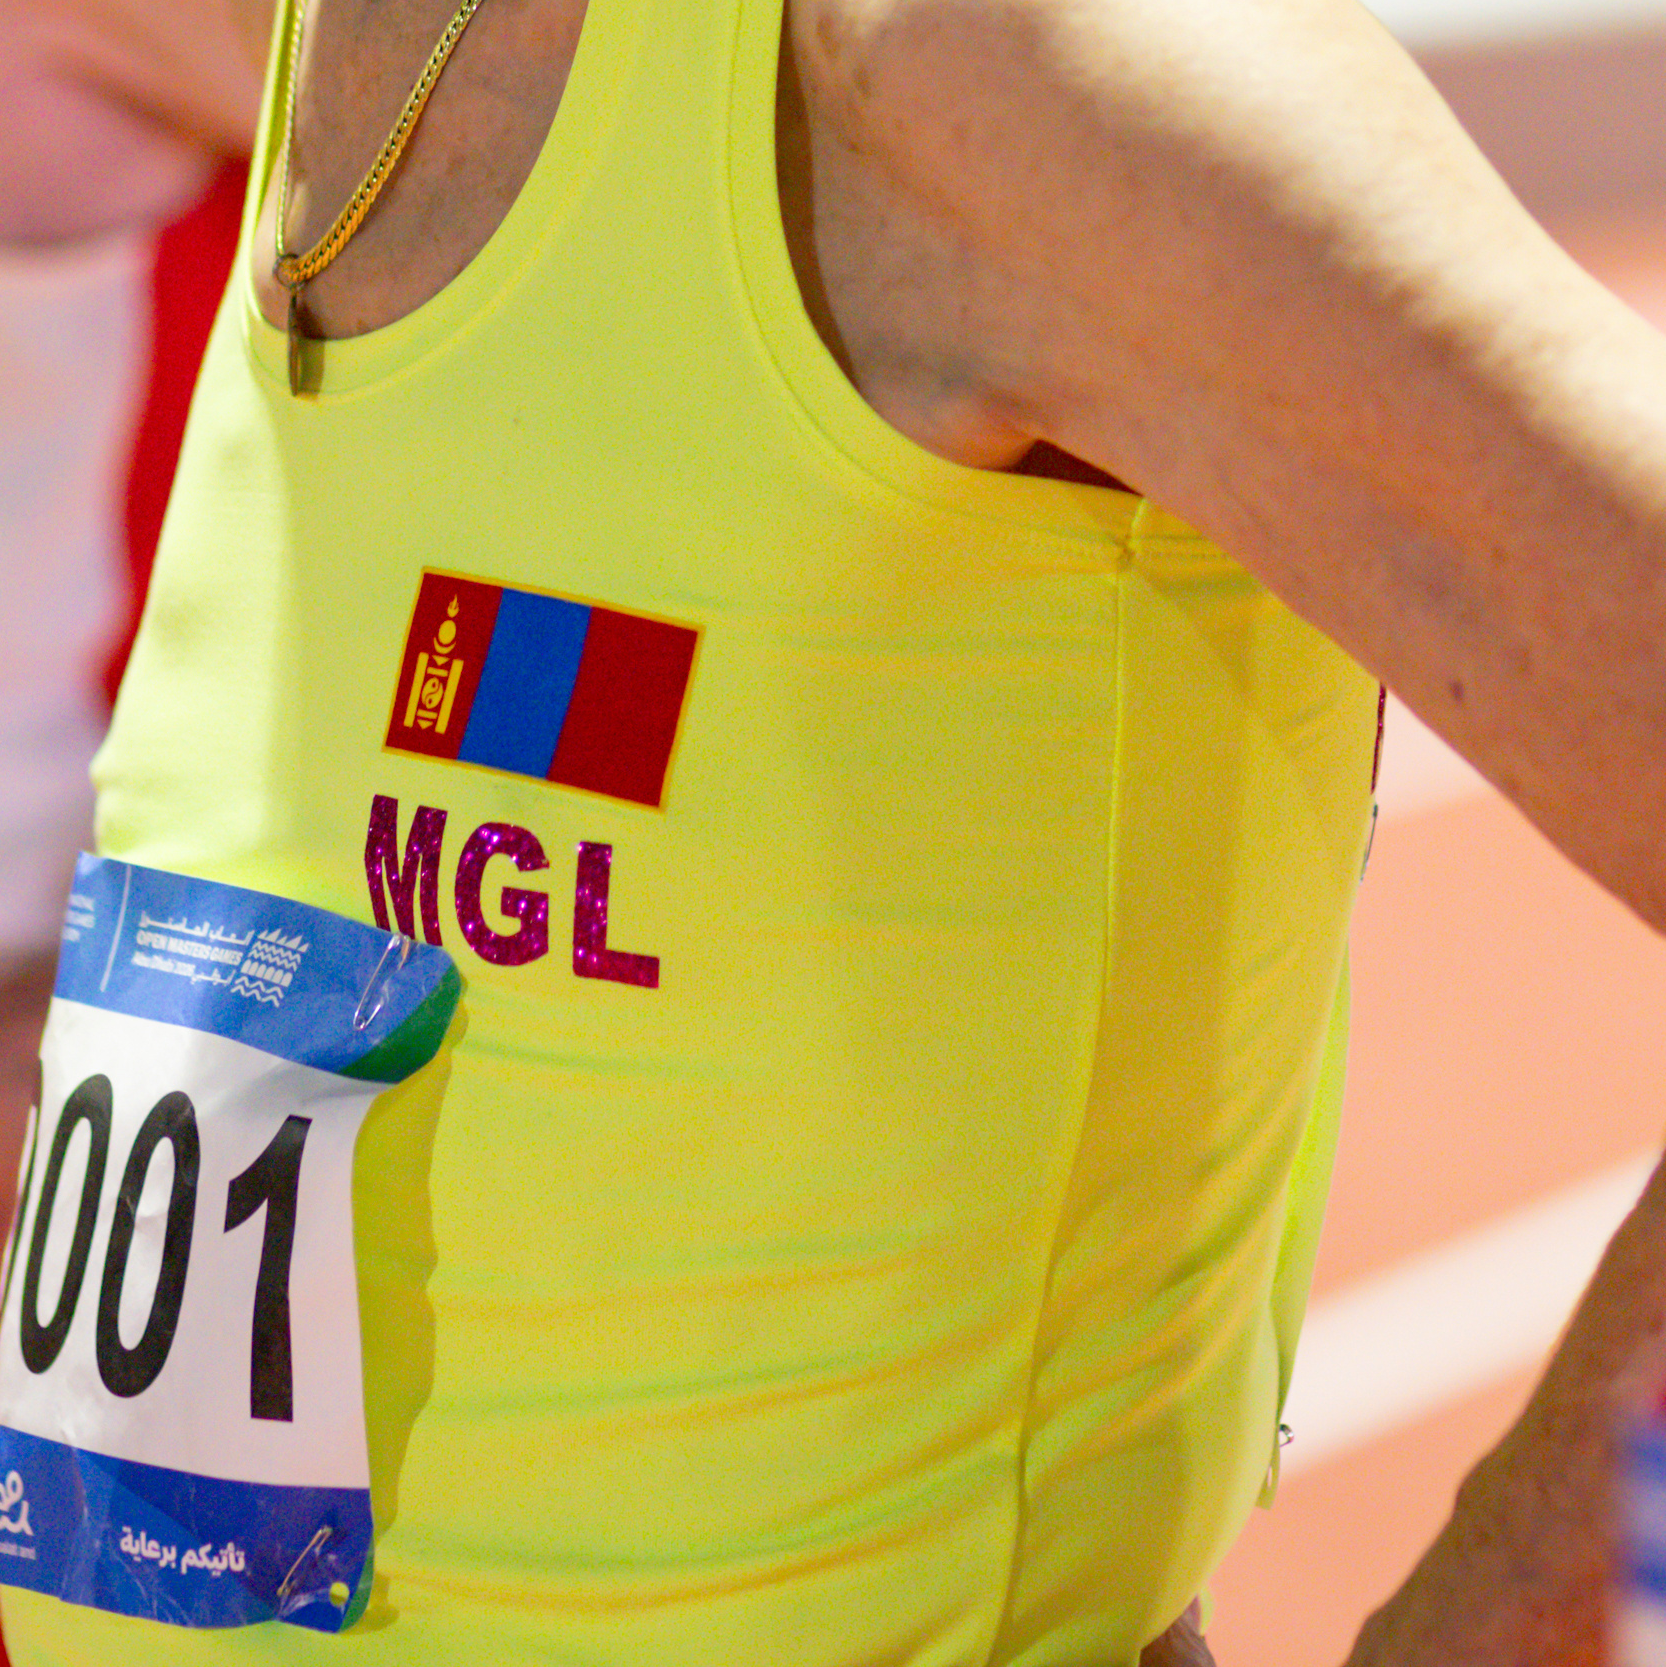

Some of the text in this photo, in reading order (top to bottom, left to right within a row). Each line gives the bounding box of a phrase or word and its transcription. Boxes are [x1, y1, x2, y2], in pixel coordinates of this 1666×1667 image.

[363, 794, 661, 989] MGL
[136, 928, 167, 950] OPEN
[167, 934, 211, 961] MASTERS
[209, 945, 244, 966] GAMES
[119, 1525, 246, 1577] تأتيكم برعاية
